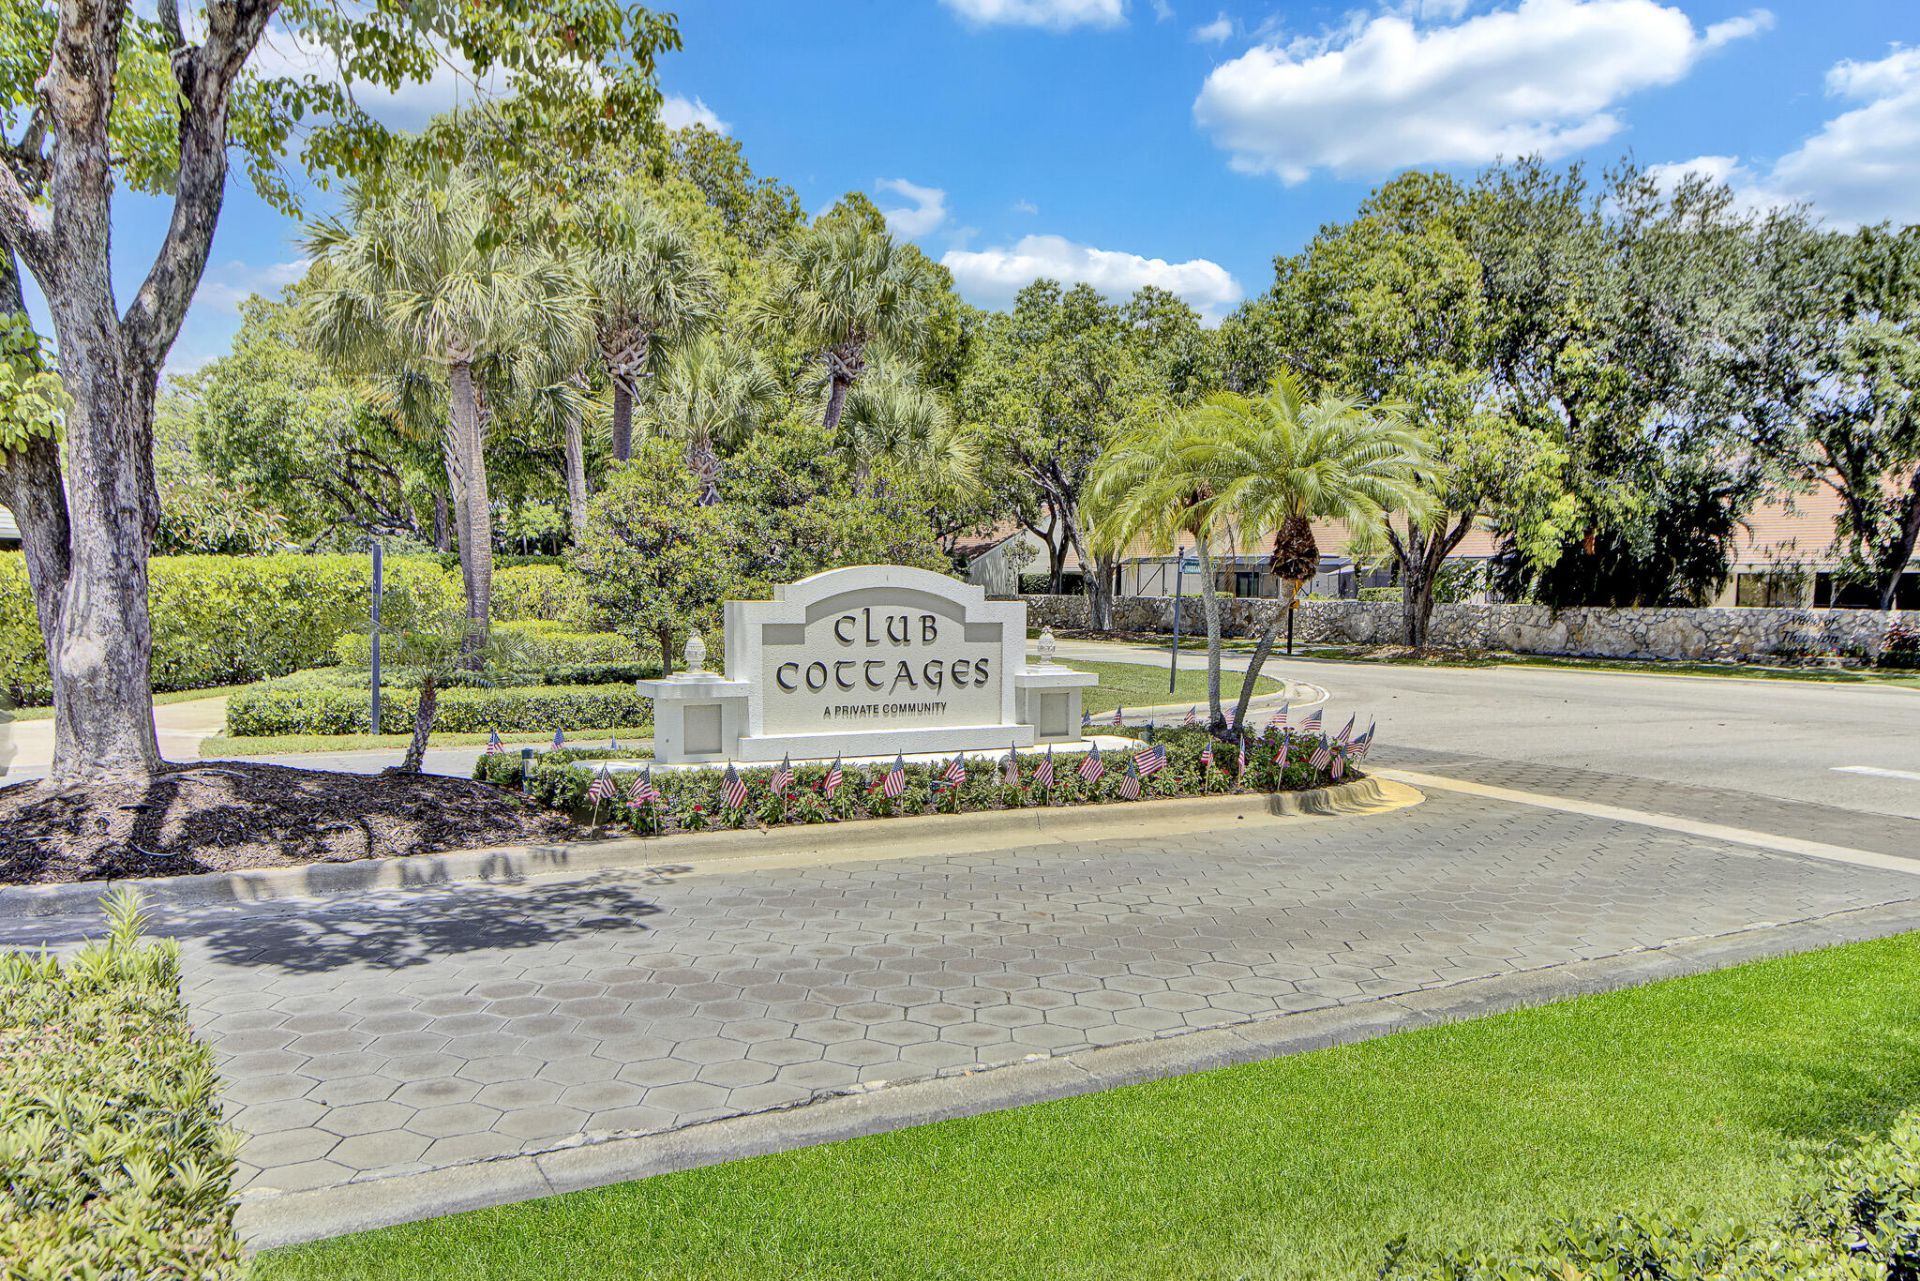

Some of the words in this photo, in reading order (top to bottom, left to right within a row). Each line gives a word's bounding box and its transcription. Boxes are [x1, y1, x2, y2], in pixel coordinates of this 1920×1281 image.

[1824, 615, 1840, 630] of
[776, 658, 989, 695] COTTAGES
[824, 705, 832, 716] A
[834, 704, 880, 716] PRIVATE
[882, 702, 947, 714] COMMUNITY
